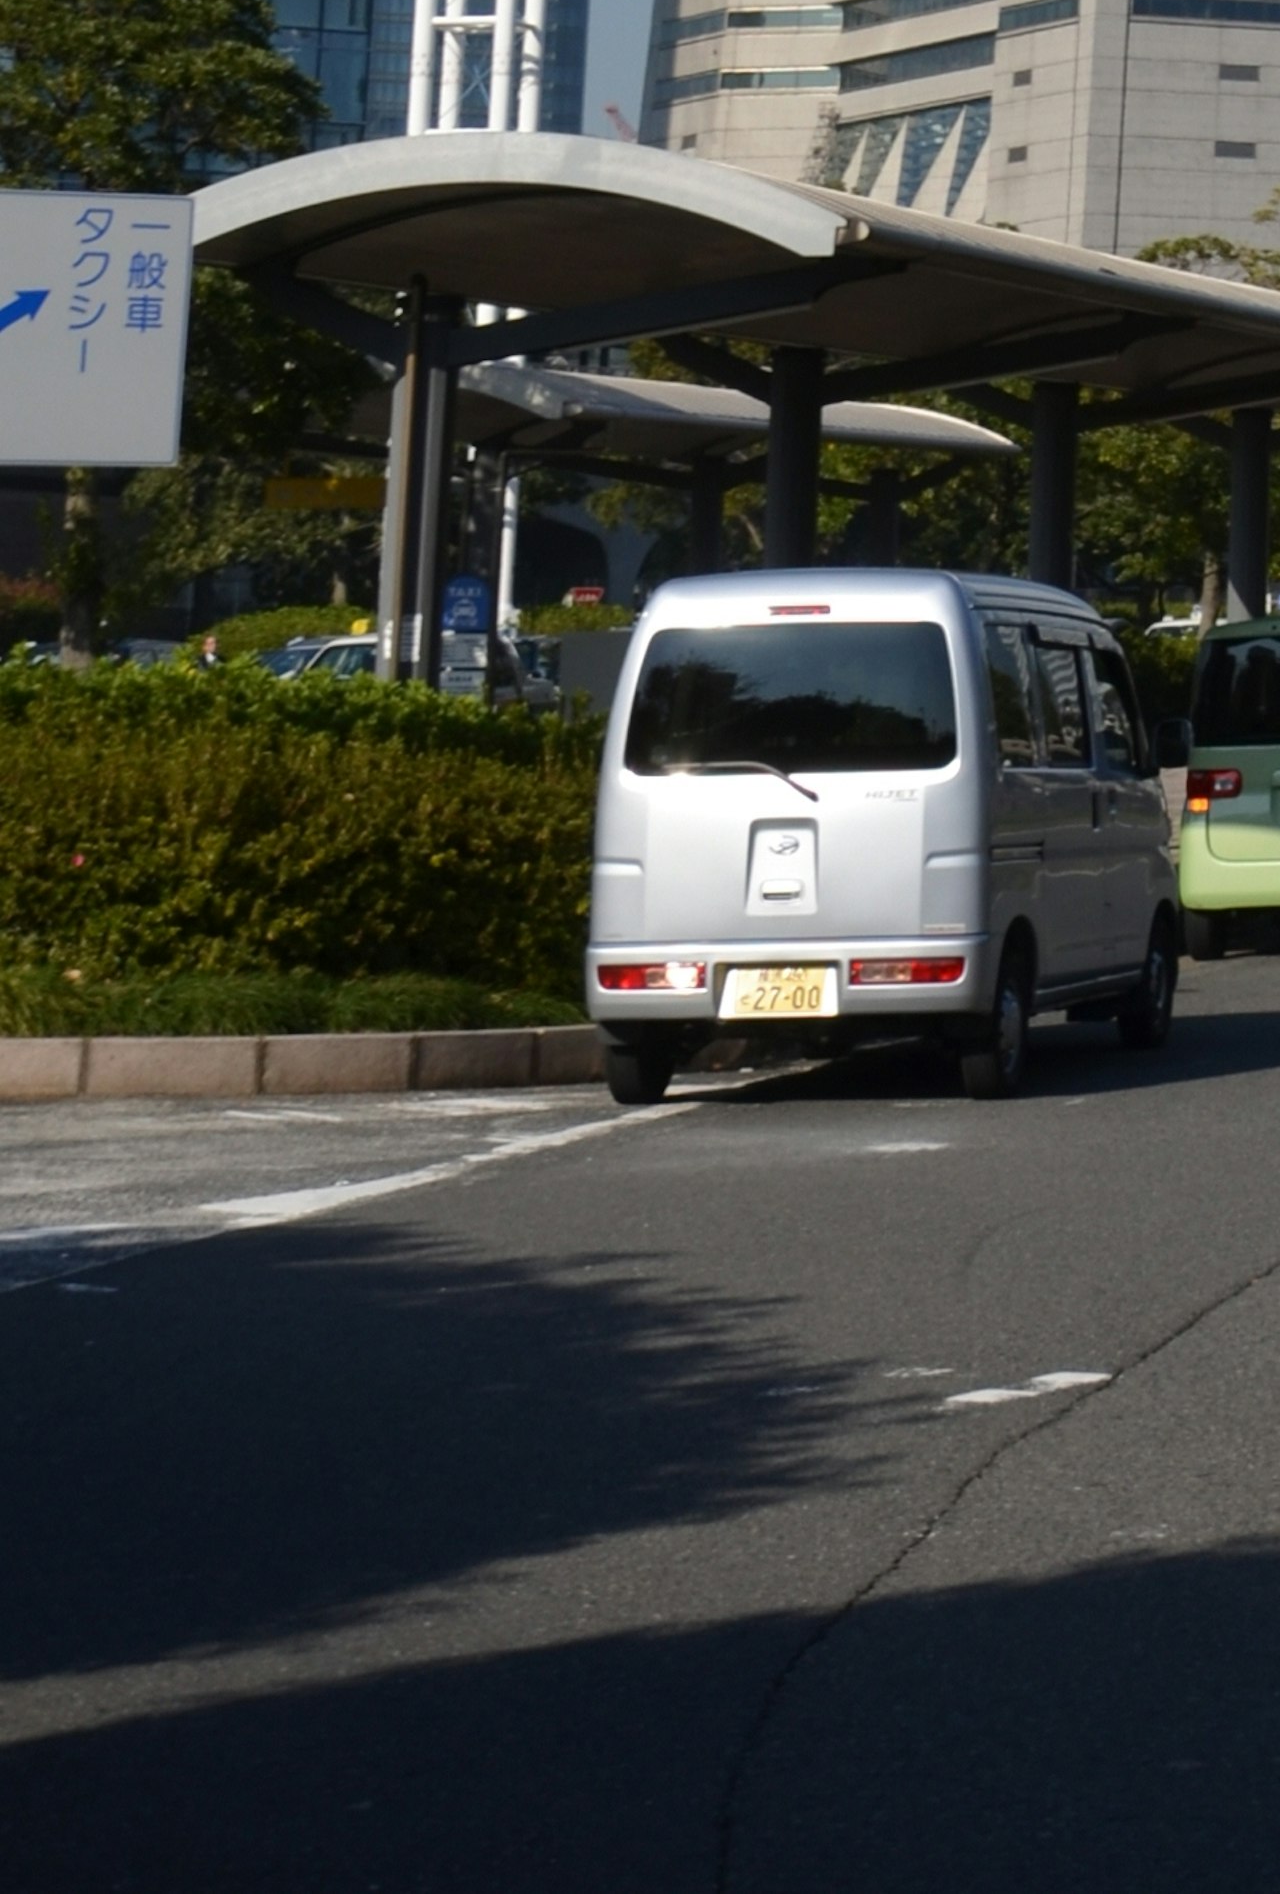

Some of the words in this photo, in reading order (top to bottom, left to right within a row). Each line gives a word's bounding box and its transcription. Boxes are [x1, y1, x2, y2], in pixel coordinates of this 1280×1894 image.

[68, 207, 114, 373] タクシー
[124, 223, 171, 333] 一般車
[447, 586, 482, 598] TAXI
[865, 788, 918, 799] HIJET
[753, 986, 821, 1011] 27-00
